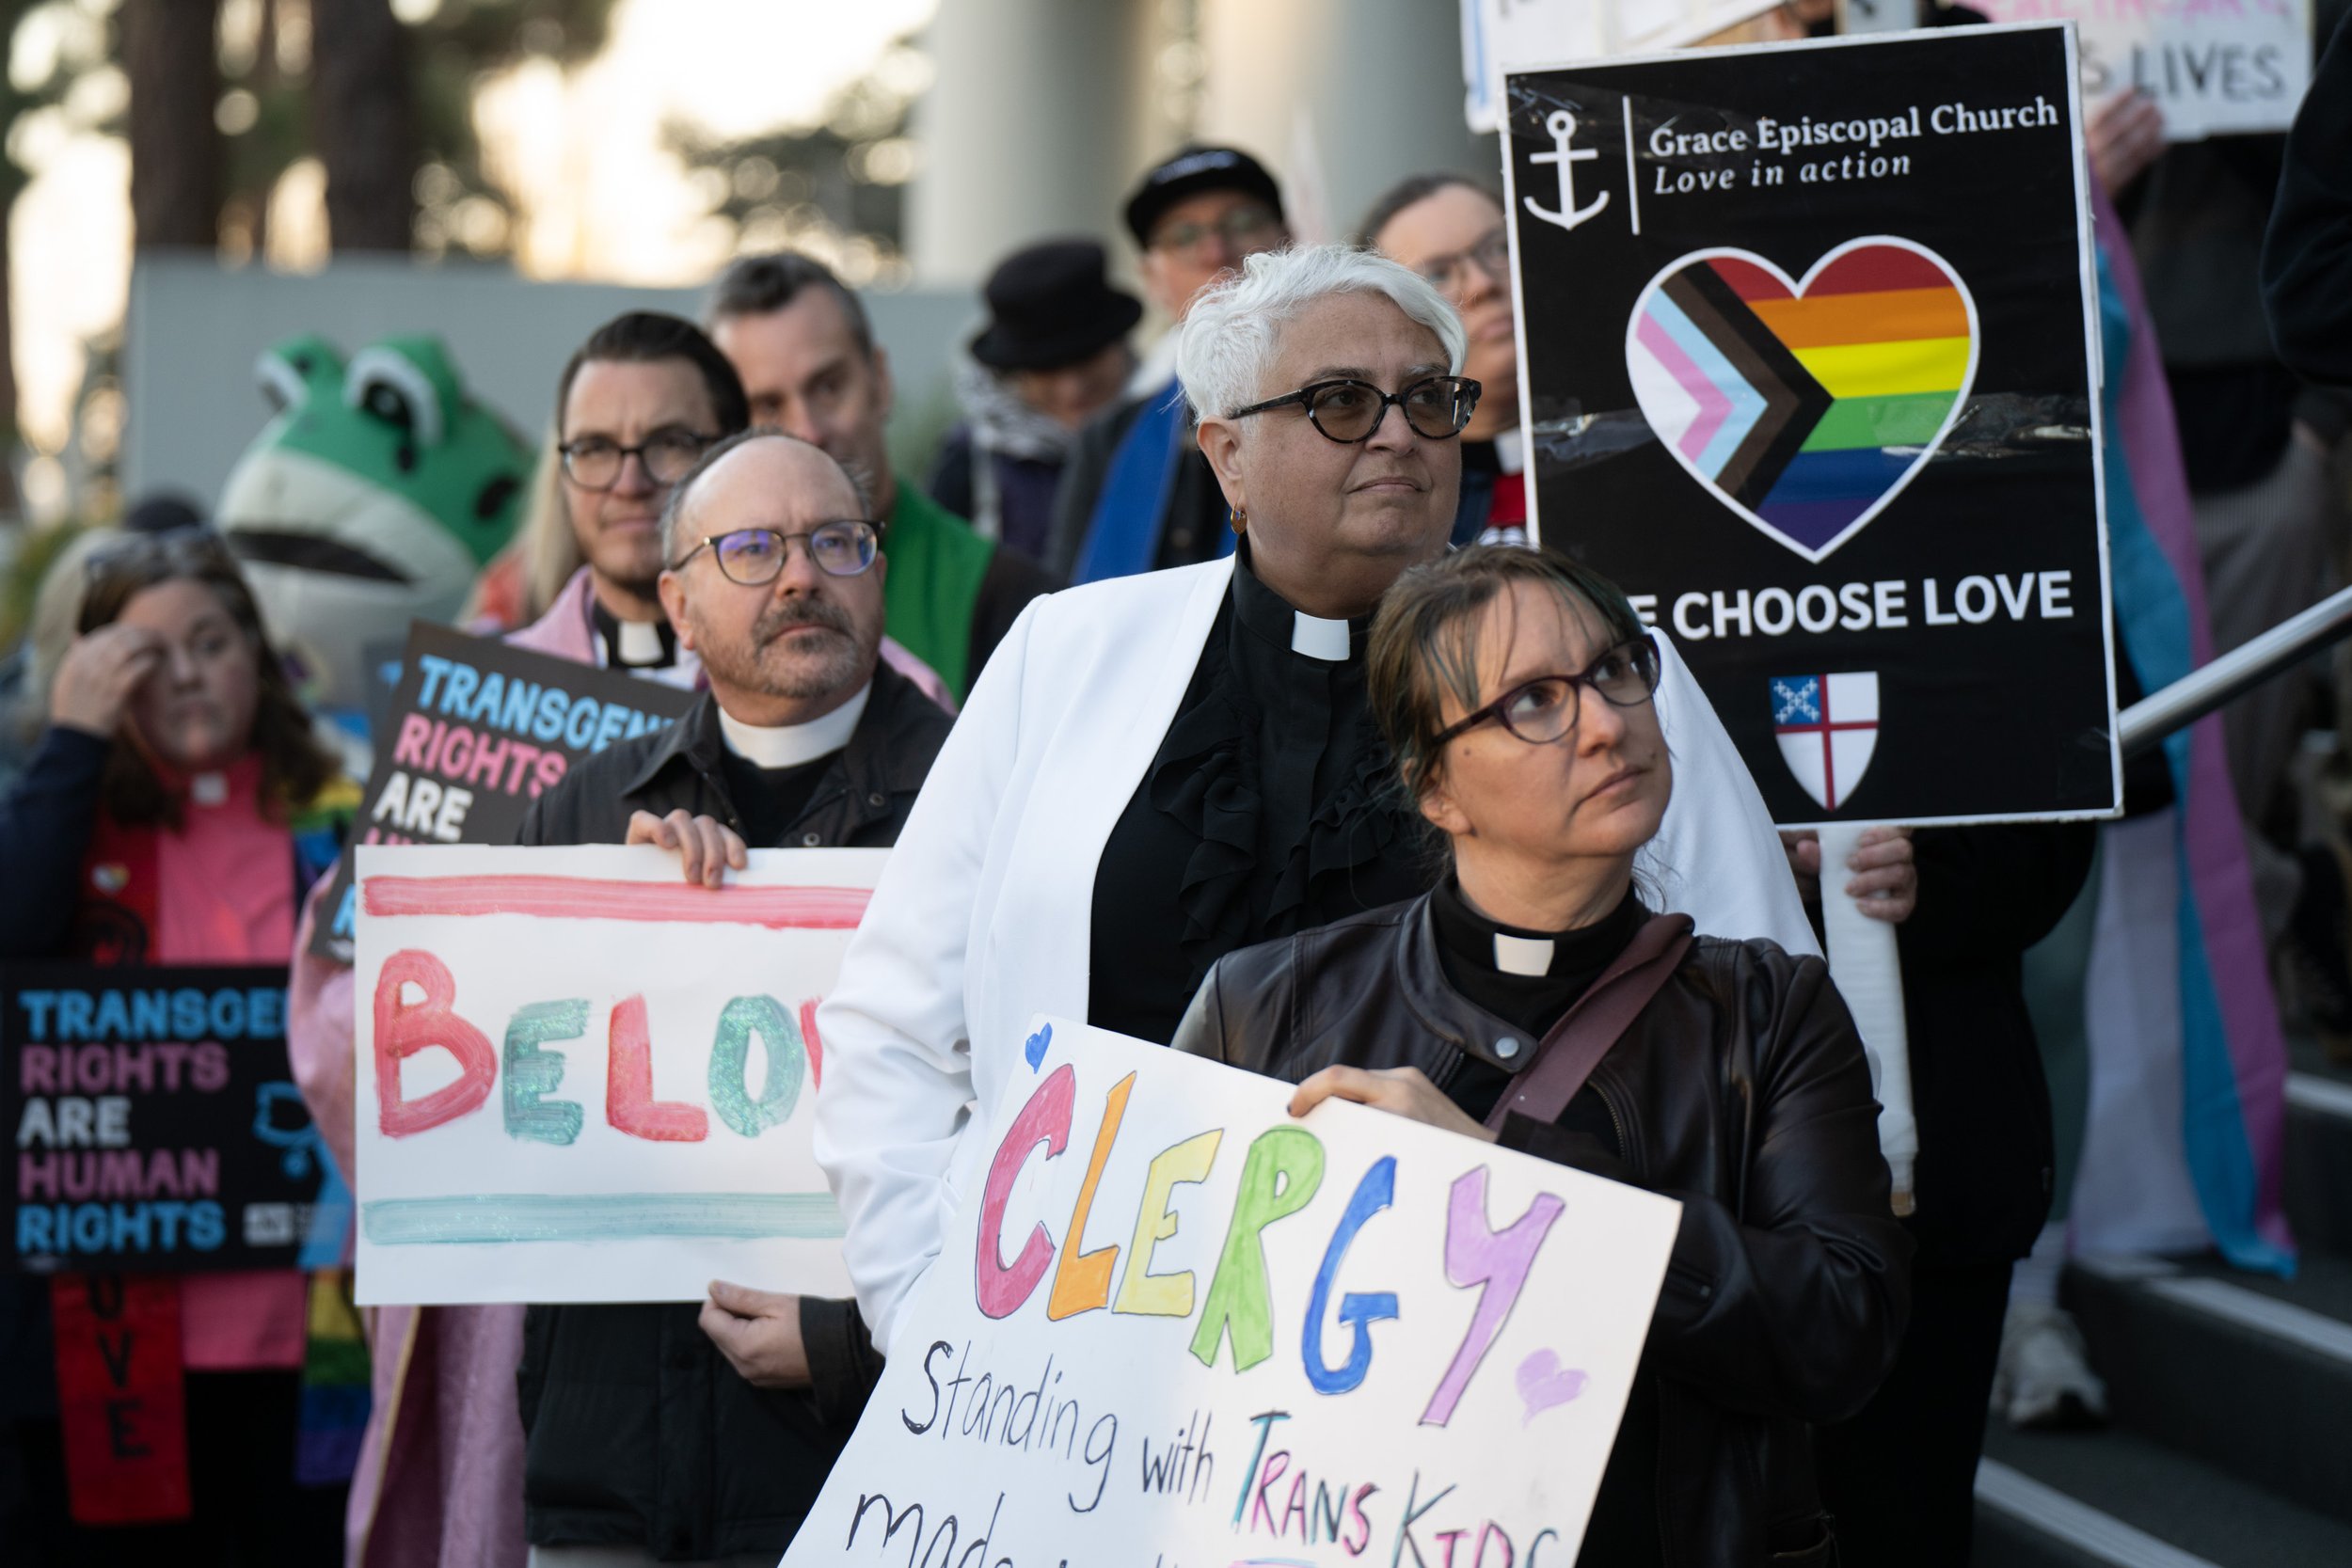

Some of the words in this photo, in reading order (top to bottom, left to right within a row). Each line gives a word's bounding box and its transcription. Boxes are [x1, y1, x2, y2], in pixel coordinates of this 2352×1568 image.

[1649, 120, 1748, 158] Grace
[1756, 106, 1922, 155] Episcopal
[1931, 96, 2059, 135] Church
[1655, 164, 1735, 195] Love
[1751, 159, 1784, 187] in
[1800, 153, 1911, 183] action
[1672, 578, 1908, 641] CHOOSE
[1922, 569, 2074, 626] LOVE
[393, 710, 568, 800] RIGHTS
[372, 773, 474, 843] ARE
[17, 988, 288, 1039] TRANSGE
[19, 1041, 230, 1093] RIGHTS
[17, 1095, 133, 1148] ARE
[17, 1148, 221, 1200] HUMAN
[15, 1199, 228, 1253] RIGHTS
[974, 1063, 1565, 1429] CLERGY
[901, 1339, 1118, 1513] Standing
[1141, 1409, 1214, 1506] with
[1231, 1409, 1381, 1558] TRANS
